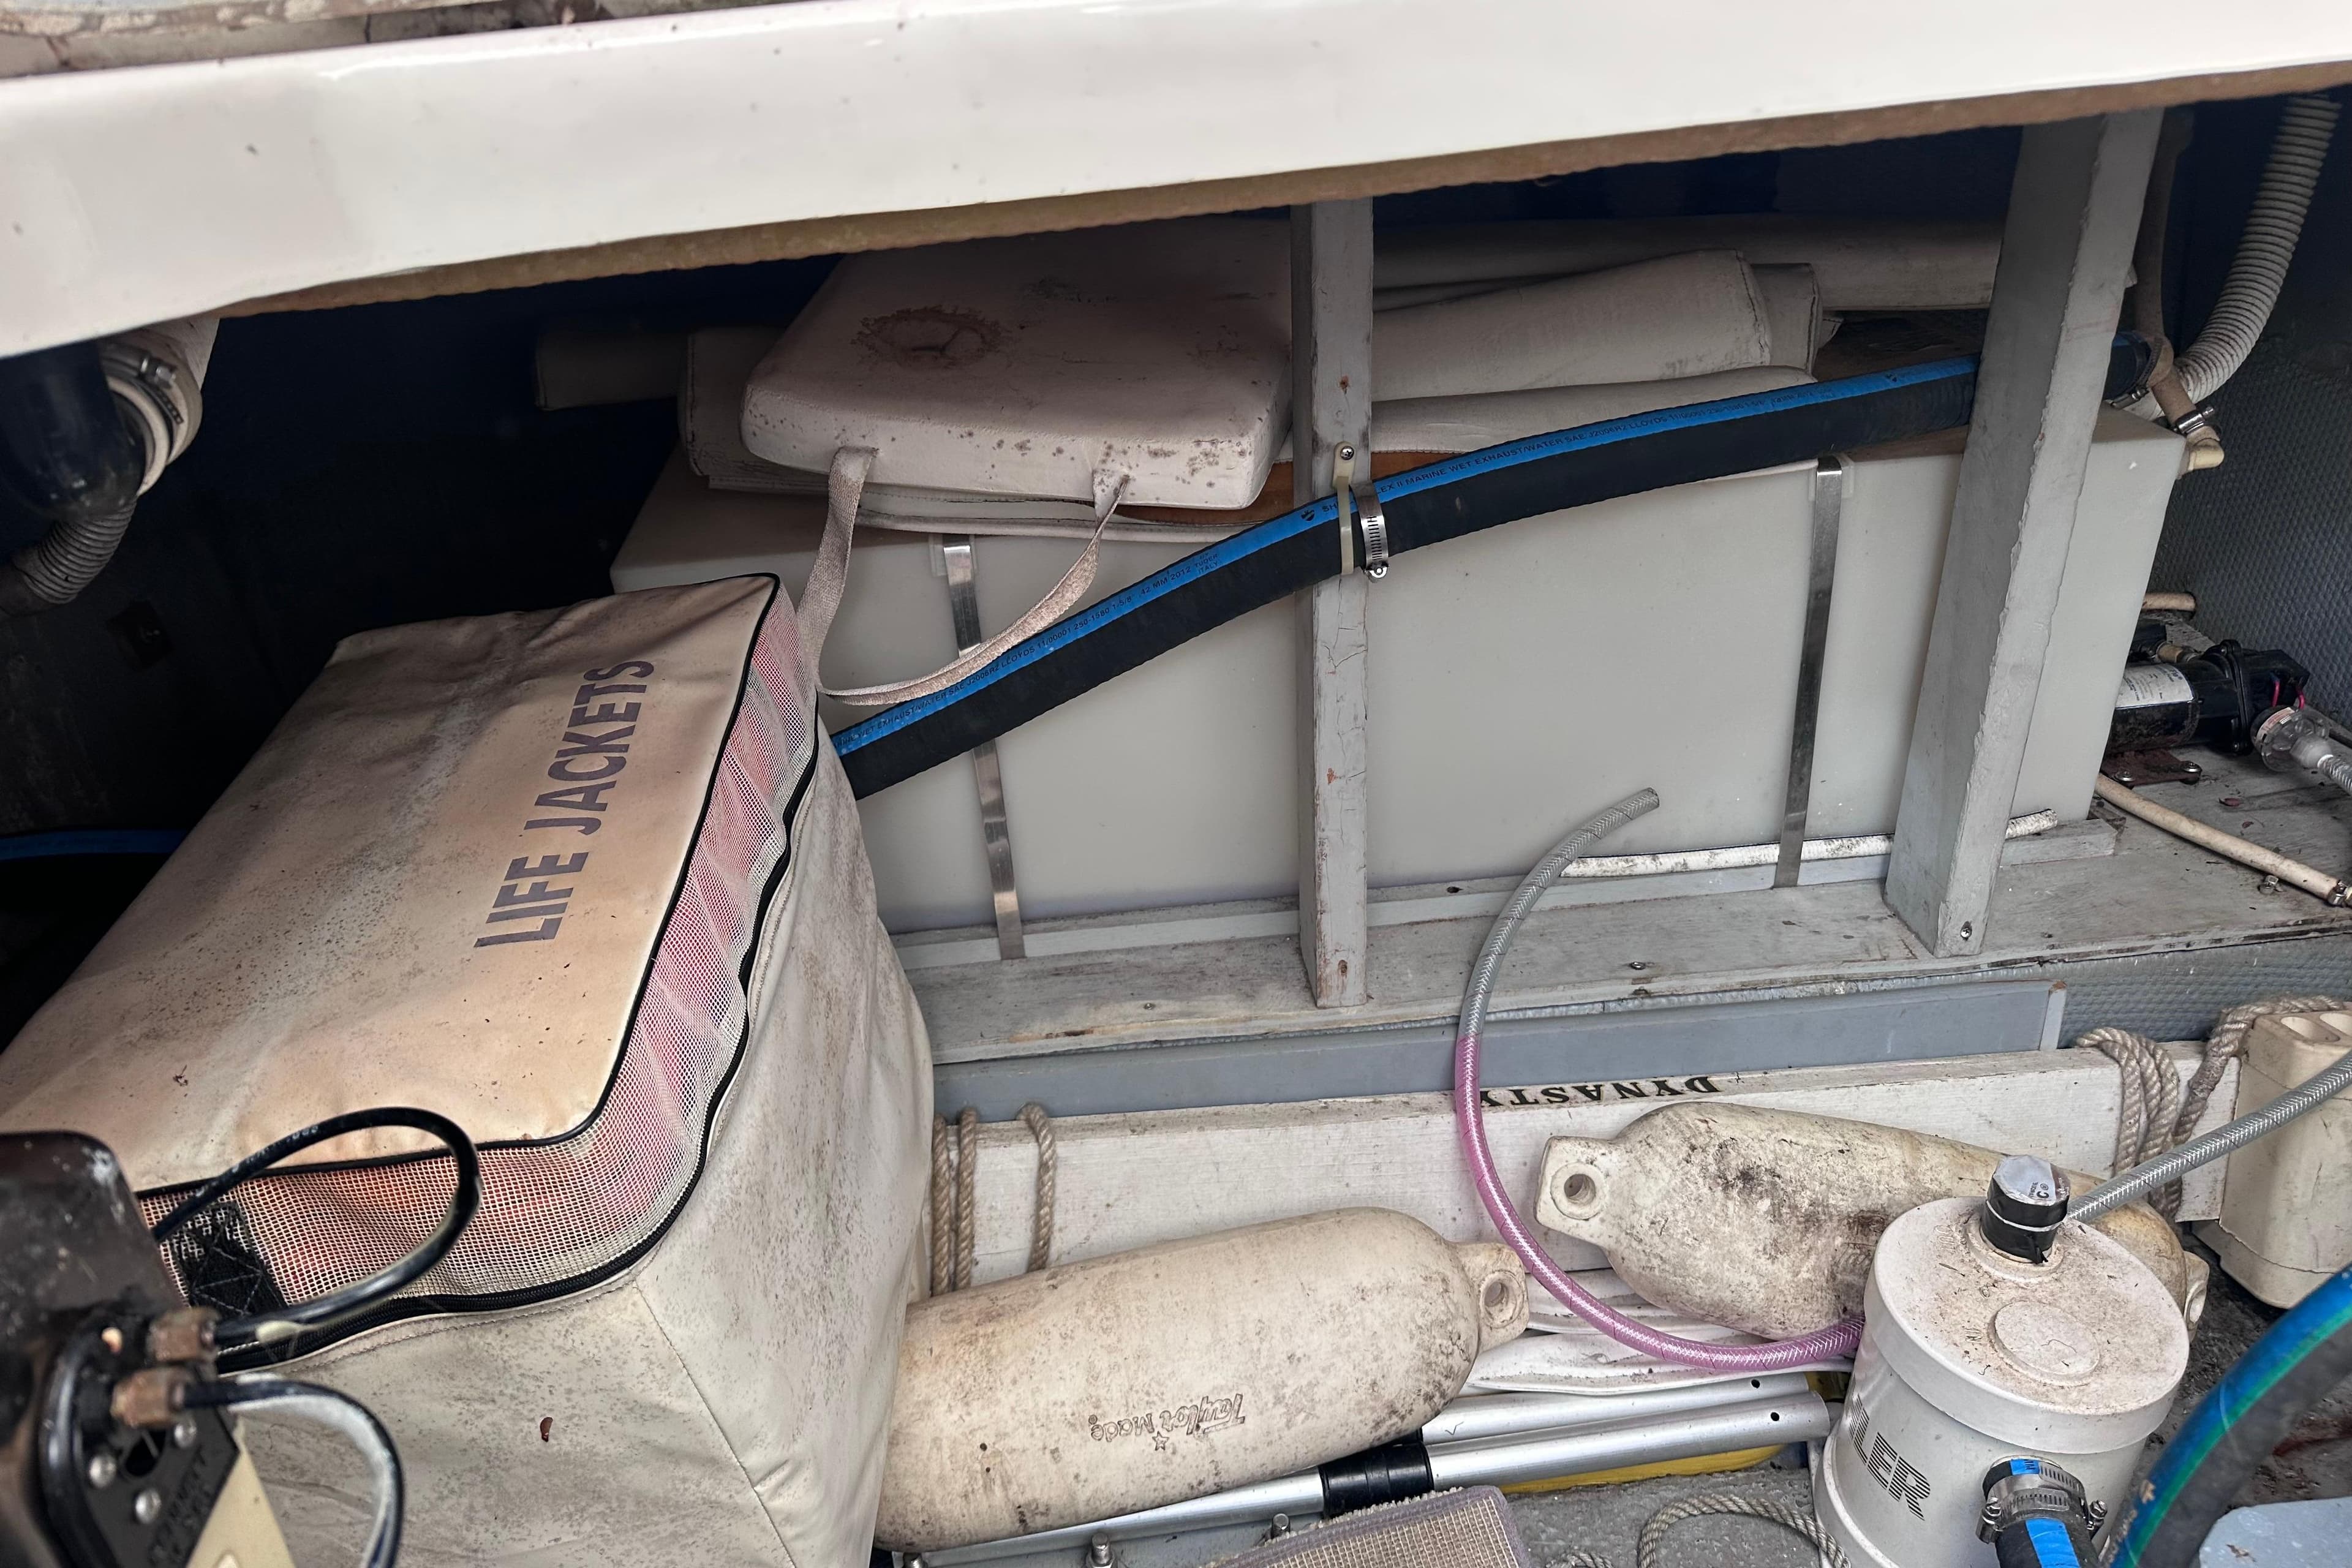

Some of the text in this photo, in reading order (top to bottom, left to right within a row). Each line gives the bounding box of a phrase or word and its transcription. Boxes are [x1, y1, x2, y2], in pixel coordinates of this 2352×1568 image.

[1405, 468, 1447, 483] MARINE
[1449, 460, 1472, 470] WET
[1476, 438, 1562, 462] EXHAUST/WATER
[1564, 432, 1584, 441] SAE
[1629, 415, 1667, 428] LLOYDS
[1197, 560, 1219, 573] ITALY
[948, 682, 965, 694] SAE
[967, 665, 999, 684] J2006R2
[1001, 646, 1035, 666] LLOYDS
[1074, 608, 1110, 629] 250-1580
[1152, 577, 1168, 588] MM
[1169, 565, 1192, 580] 2012
[473, 660, 654, 948] LIFE JACKETS
[1479, 1076, 1721, 1108] DYNASTY
[1159, 1393, 1246, 1436] Taylor
